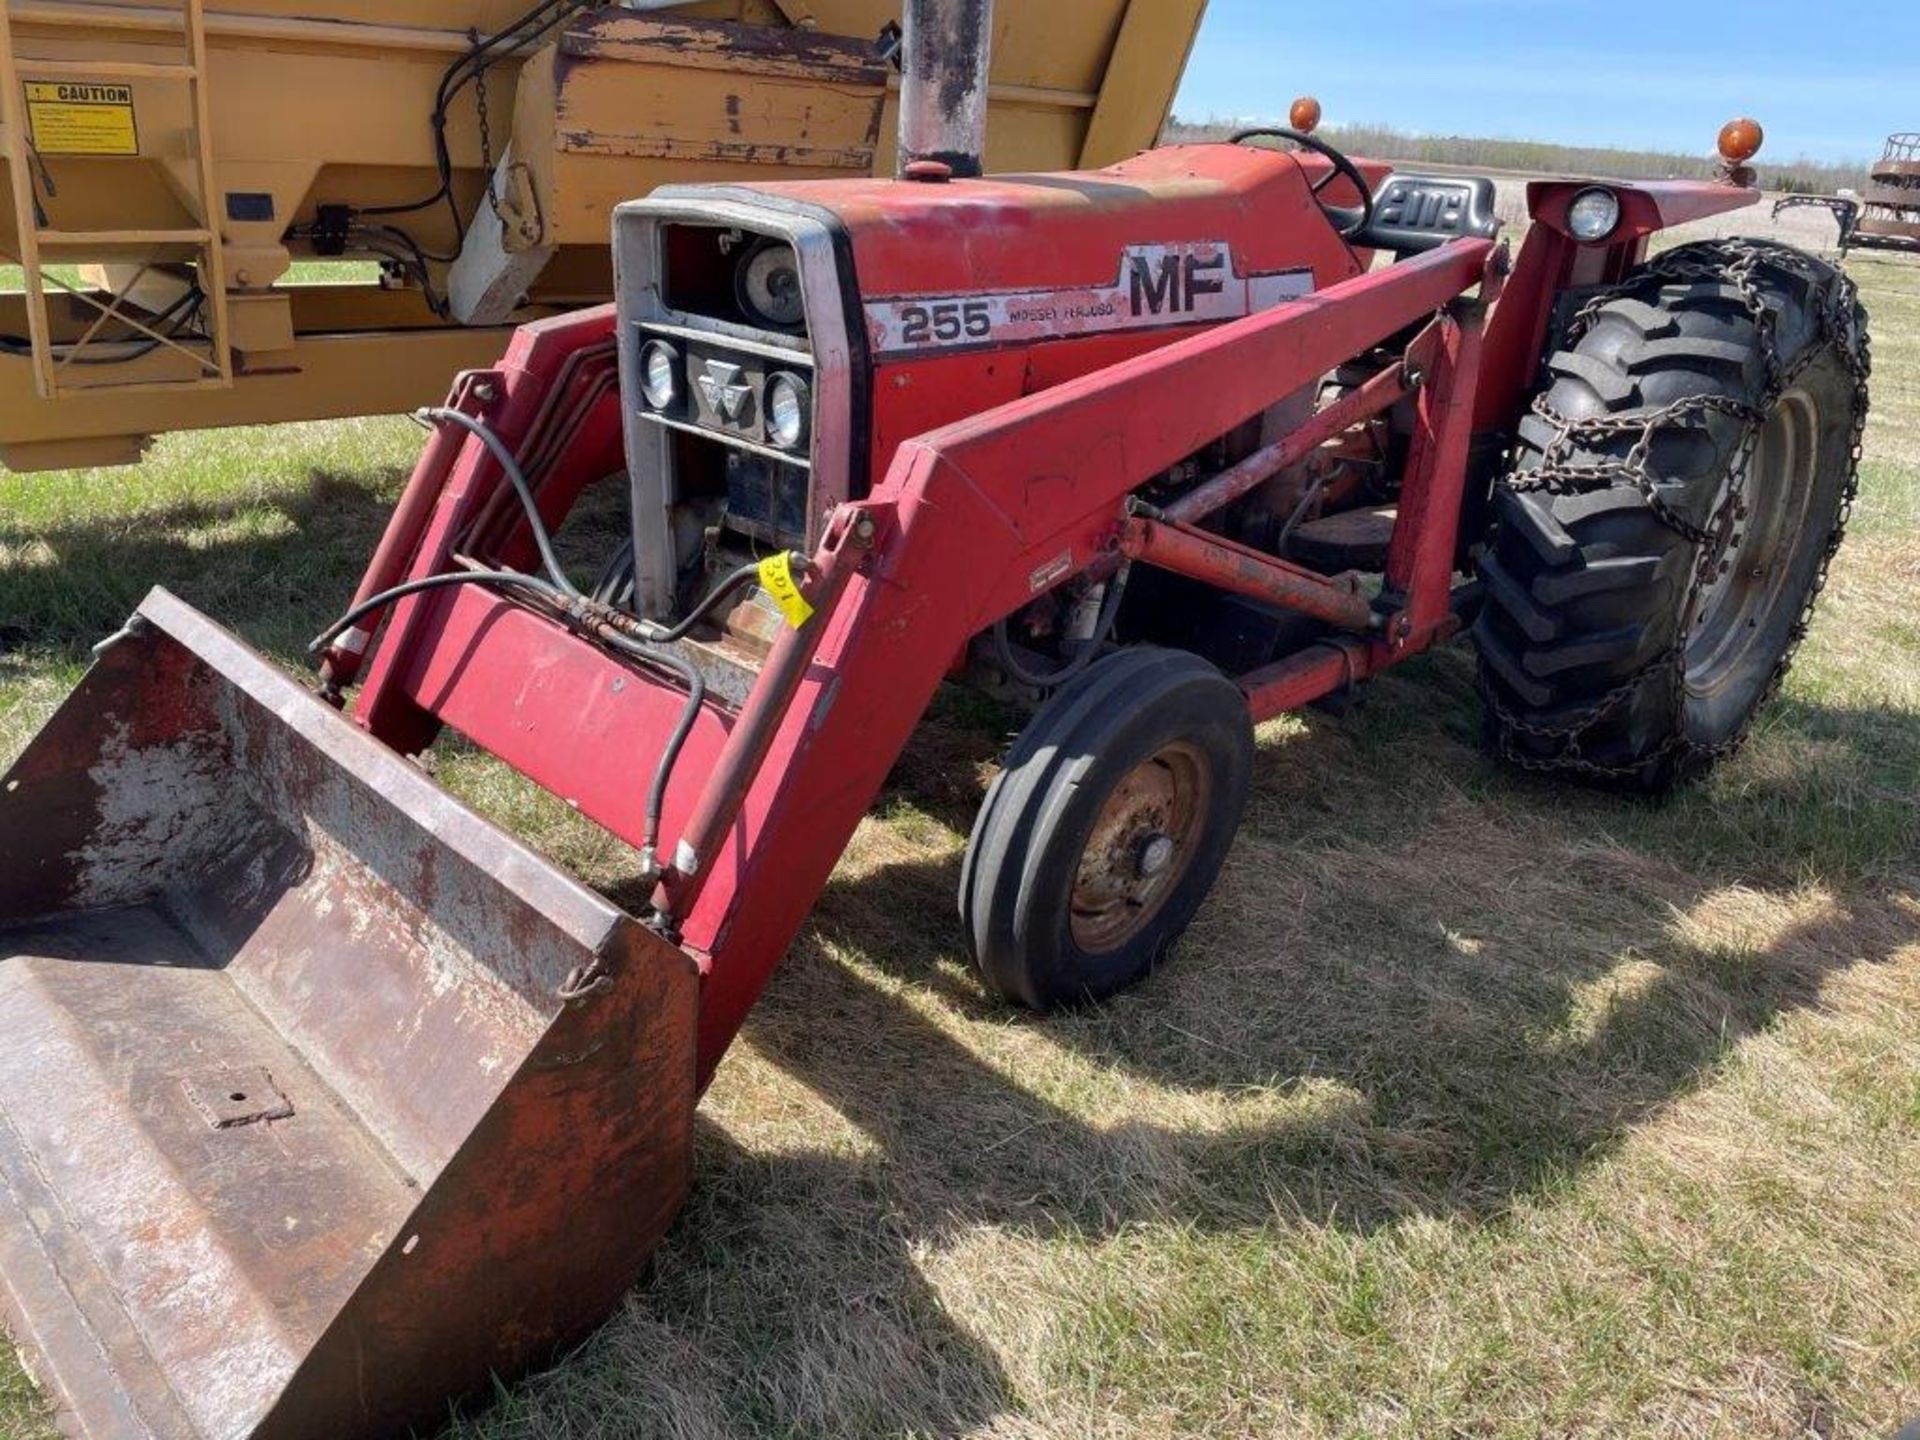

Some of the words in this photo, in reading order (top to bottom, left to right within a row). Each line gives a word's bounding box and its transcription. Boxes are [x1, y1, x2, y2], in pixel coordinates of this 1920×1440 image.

[57, 86, 129, 101] CAUTION
[1130, 252, 1225, 316] MF
[901, 302, 991, 343] 255
